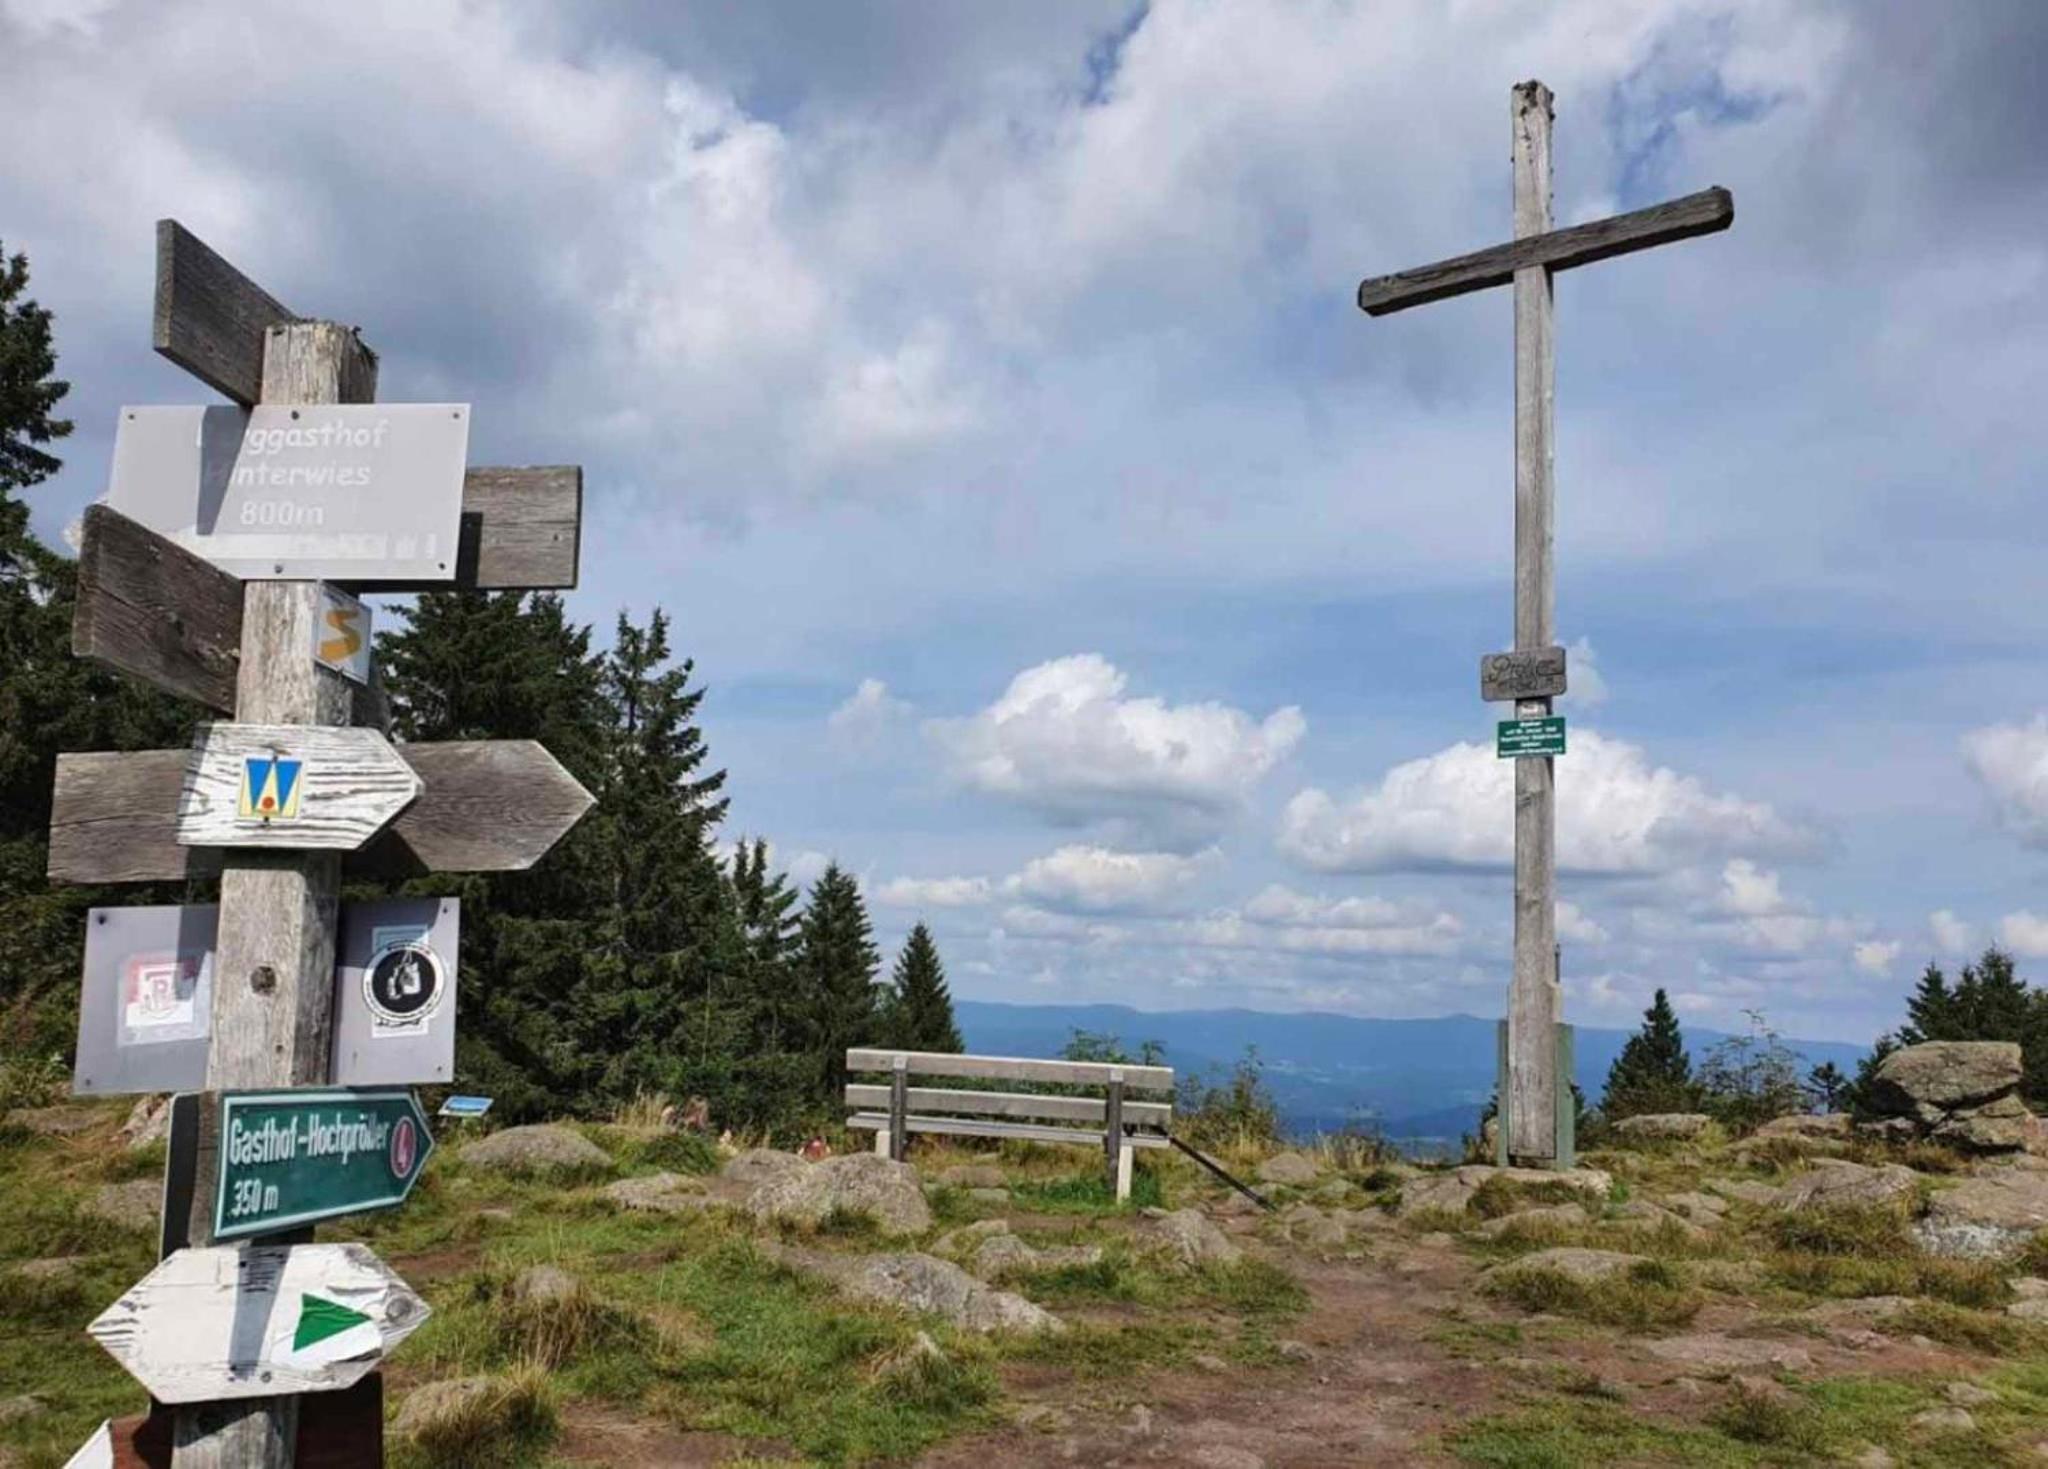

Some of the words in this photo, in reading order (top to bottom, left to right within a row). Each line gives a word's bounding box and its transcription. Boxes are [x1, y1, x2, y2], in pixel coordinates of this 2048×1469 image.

[197, 419, 389, 455] ggasthof
[240, 501, 324, 526] 800m
[231, 1179, 262, 1217] 350
[264, 1184, 279, 1211] m
